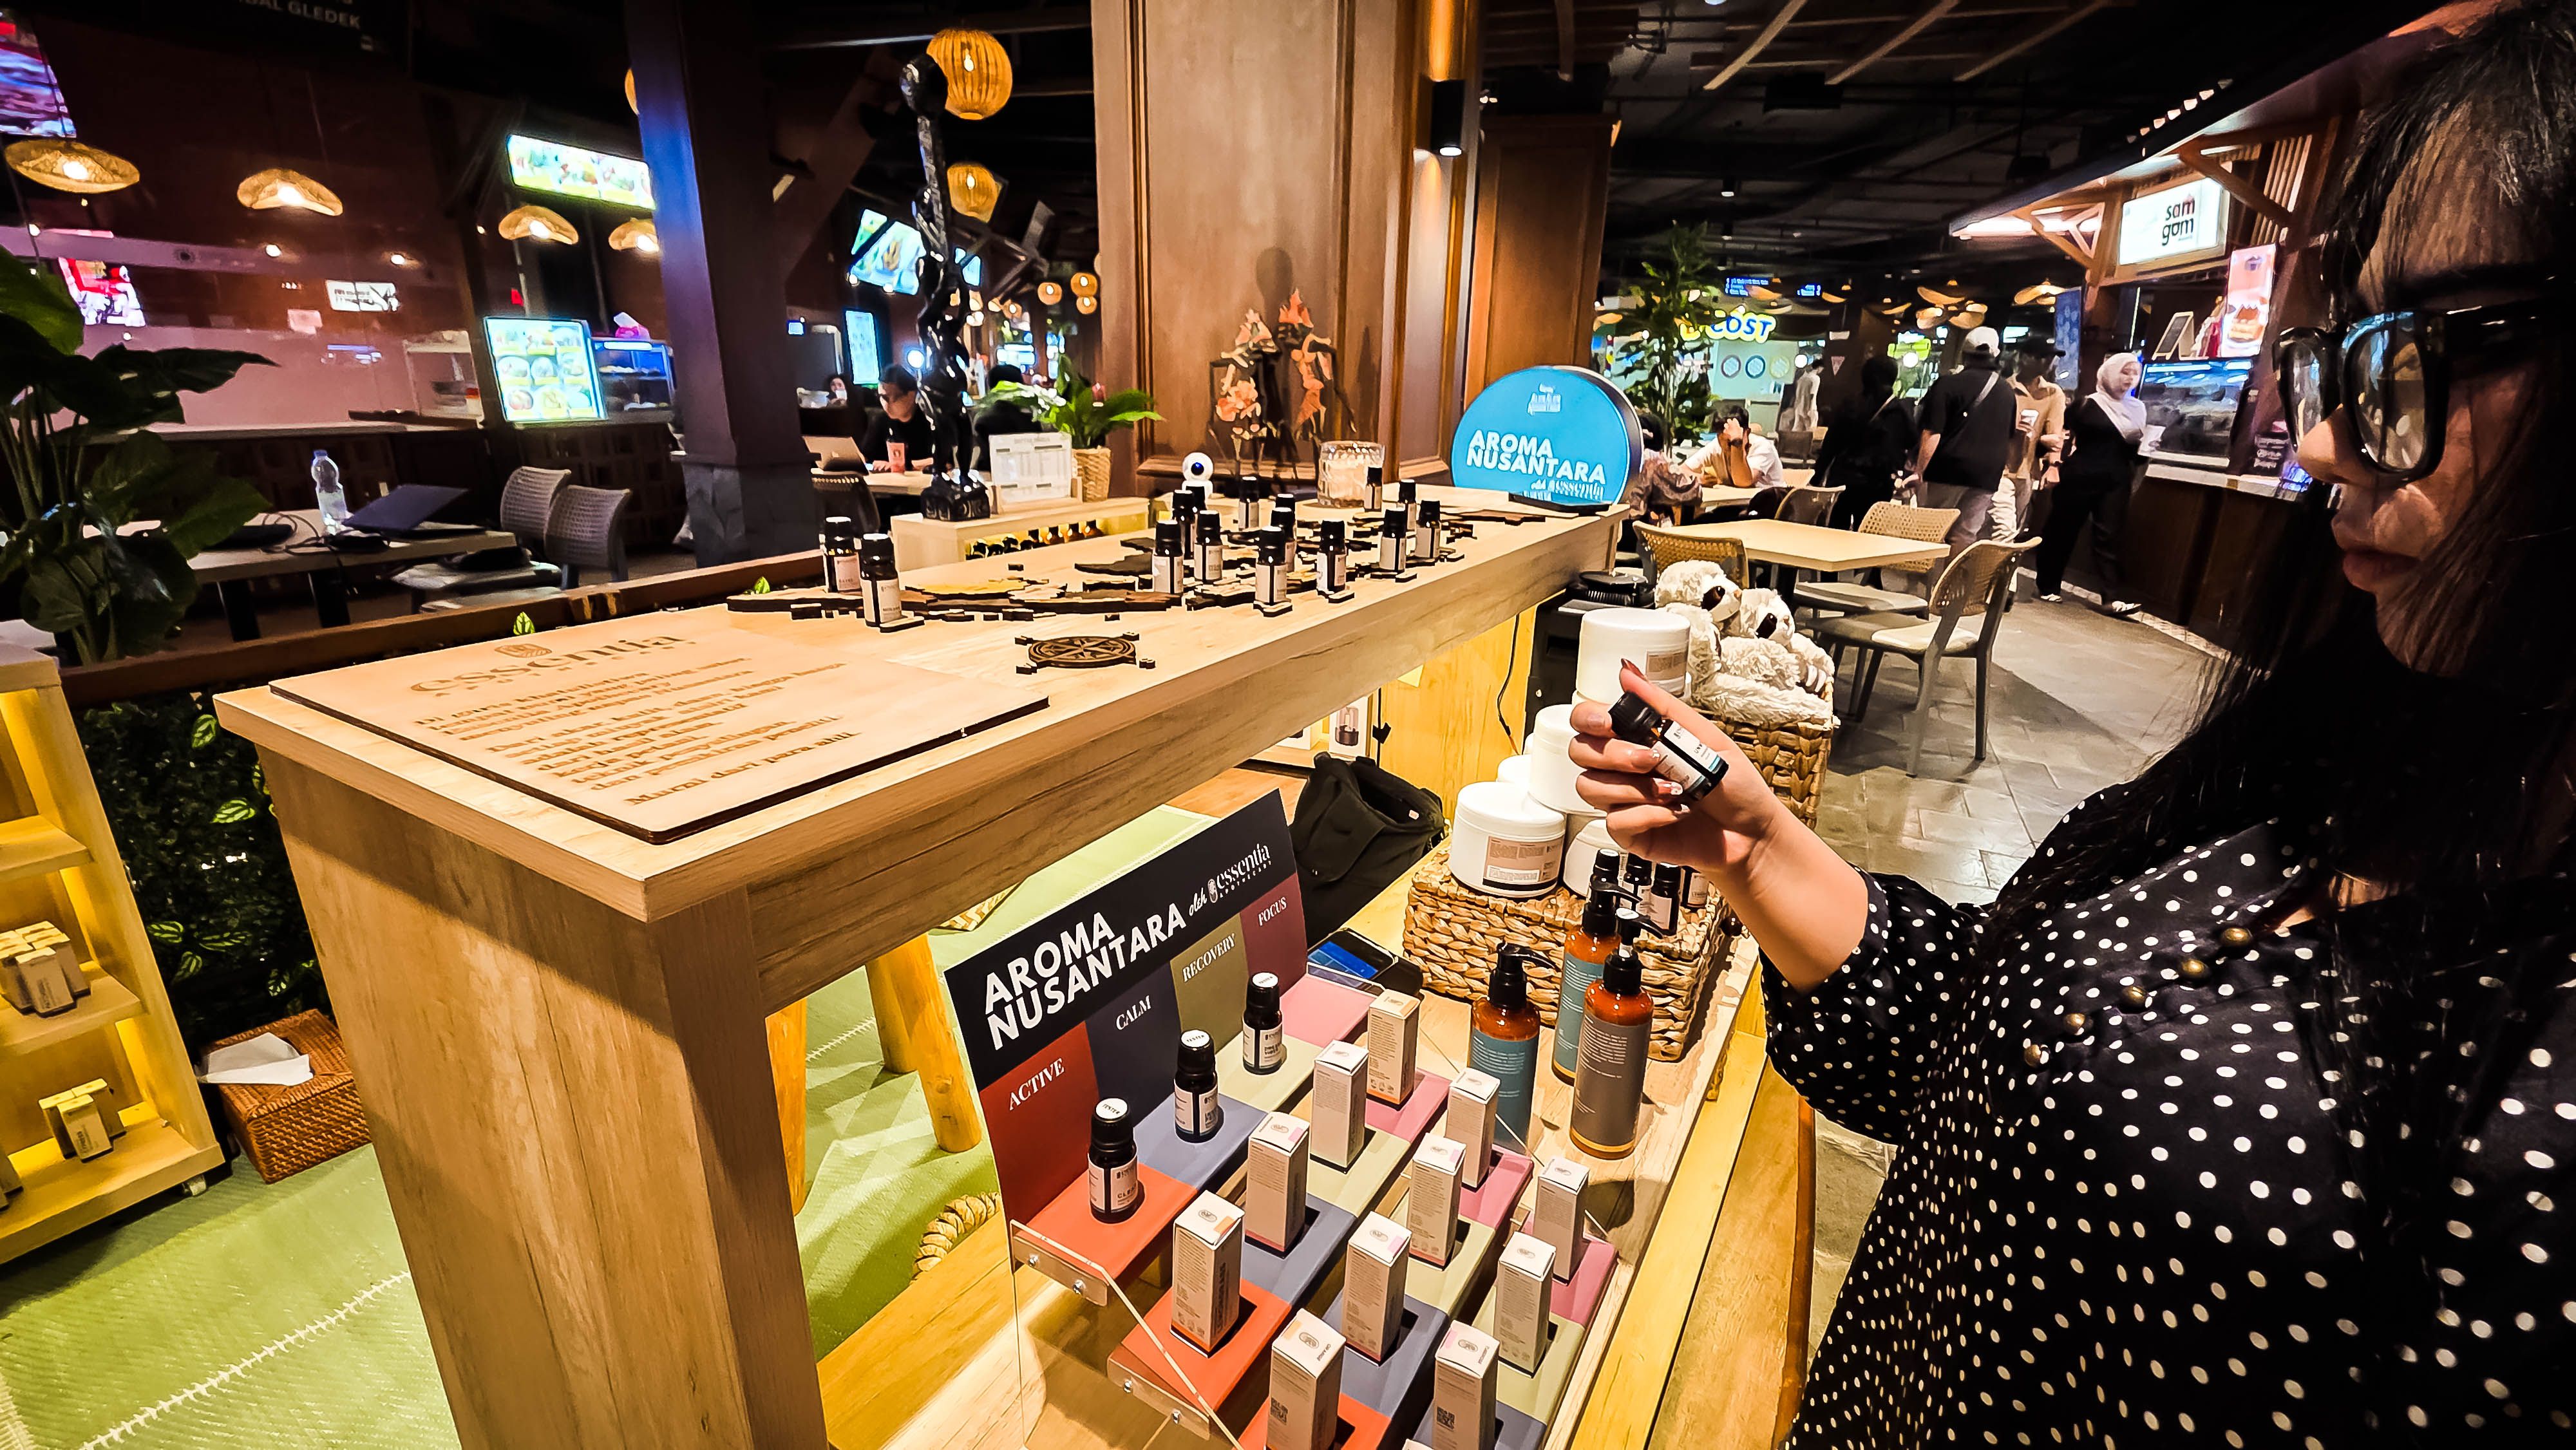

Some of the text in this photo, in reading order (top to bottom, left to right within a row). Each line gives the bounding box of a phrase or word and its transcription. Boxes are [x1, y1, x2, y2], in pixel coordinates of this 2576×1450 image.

[289, 1, 362, 29] GLEDEK
[2165, 197, 2195, 221] sam
[1469, 429, 1553, 458] AROMA
[1466, 446, 1606, 485] NUSANTARA
[411, 635, 687, 692] essentia
[428, 710, 513, 730] tempat
[517, 696, 576, 710] bumi
[579, 684, 633, 697] yang
[557, 683, 670, 710] Apothecary
[733, 686, 783, 699] kami
[485, 737, 545, 752] Dari
[730, 676, 793, 692] hingga
[520, 742, 607, 764] adalah
[536, 755, 592, 770] dari
[592, 738, 656, 755] hasil
[551, 736, 707, 777] kerja petani,
[591, 775, 641, 790] dan
[645, 740, 762, 775] pemikiran
[571, 760, 655, 783] teknik
[624, 778, 708, 805] Murni
[711, 762, 761, 778] dari
[762, 747, 815, 763] para
[1258, 896, 1287, 927] FOCUS
[985, 912, 1115, 1015] AROMA
[987, 843, 1271, 1051] NUSANTARA oleh essentia
[1181, 933, 1236, 983] RECOVERY
[1115, 995, 1151, 1031] CALM
[1186, 1034, 1205, 1043] TESTER
[1009, 1057, 1066, 1111] ACTIVE
[1102, 1103, 1121, 1115] TESTER
